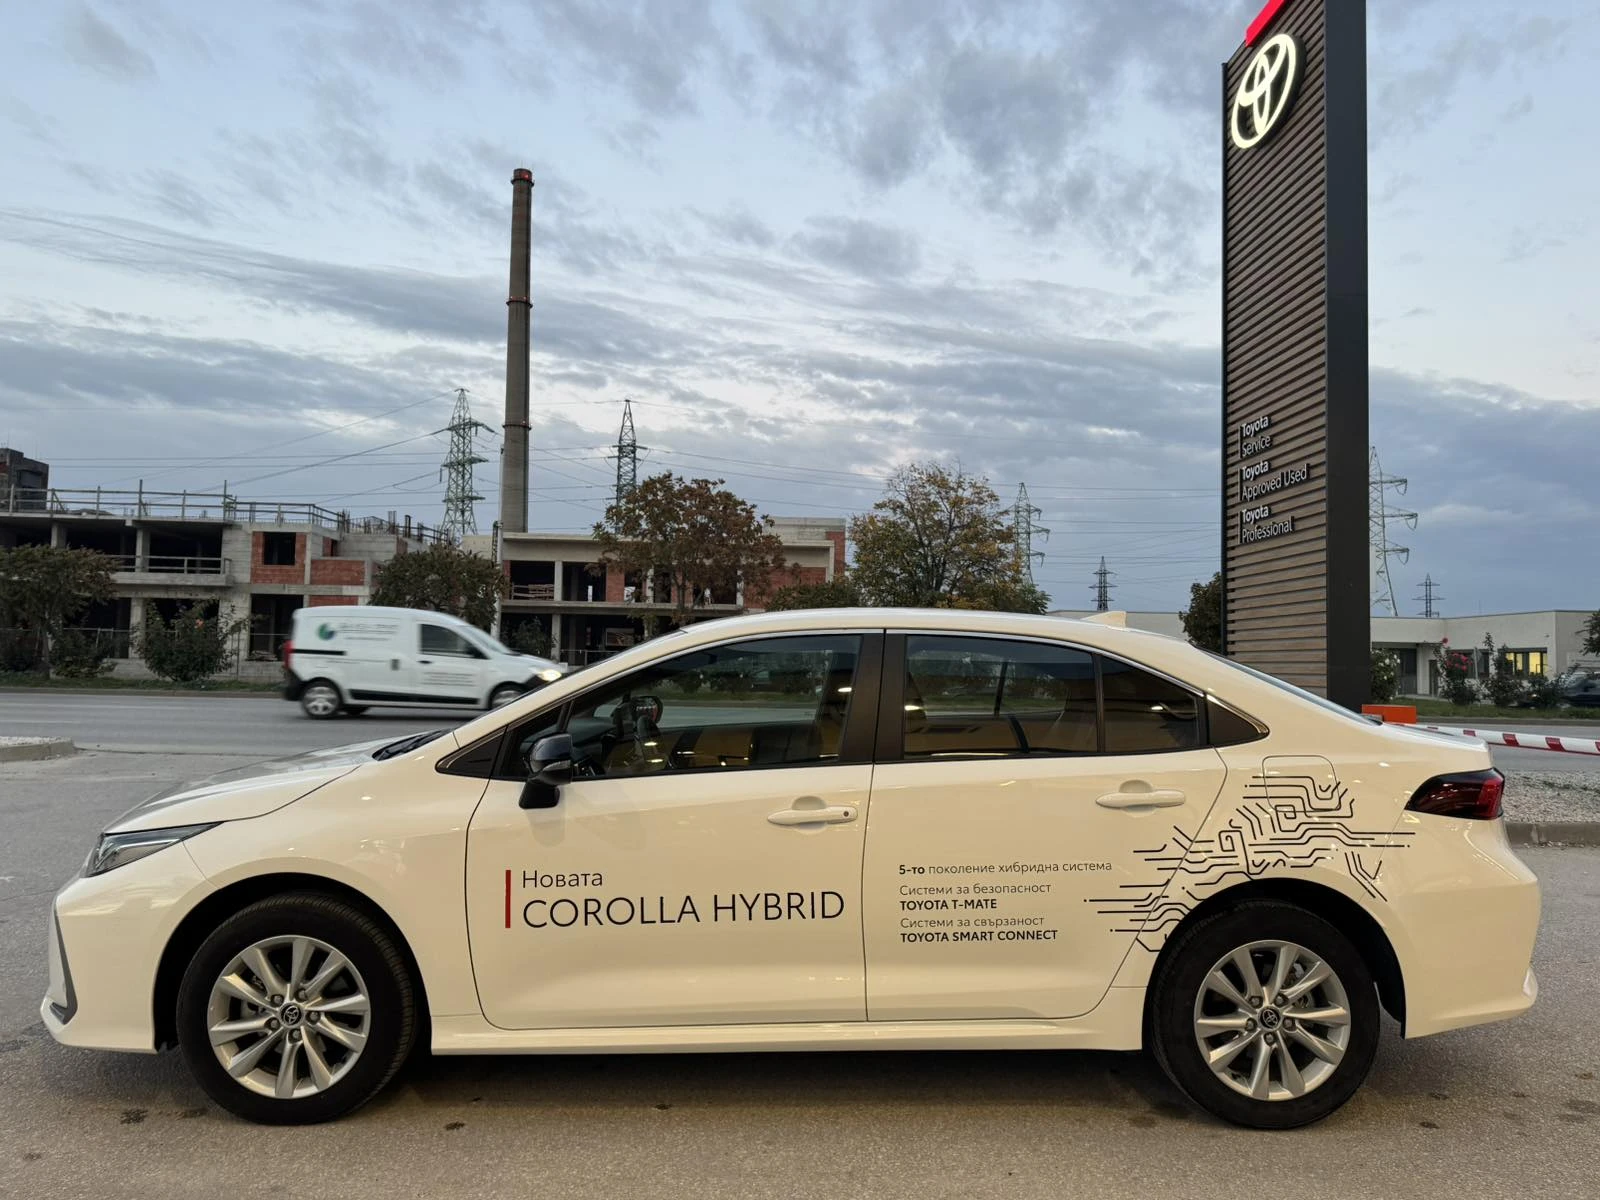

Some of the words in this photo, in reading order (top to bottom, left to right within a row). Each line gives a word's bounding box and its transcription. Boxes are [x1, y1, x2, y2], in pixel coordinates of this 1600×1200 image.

[1242, 416, 1269, 437] Toyota
[1242, 435, 1270, 457] Service
[1242, 461, 1269, 481] Toyota
[1242, 473, 1282, 501] Approved
[1283, 463, 1307, 486] Used
[1242, 506, 1269, 525] Toyota
[1242, 516, 1293, 543] Professional
[899, 864, 925, 875] 5-то
[928, 864, 995, 874] поколение
[998, 862, 1059, 874] хибридна
[1062, 861, 1112, 872] система
[522, 870, 603, 888] Новата
[899, 885, 953, 896] Системи
[955, 884, 970, 895] за
[973, 883, 1051, 895] безопасност
[523, 895, 701, 928] COROLLA
[713, 891, 845, 922] HYBRID
[900, 900, 949, 911] TOYOTA
[951, 899, 998, 910] T-MATE
[900, 918, 953, 929] Системи
[956, 917, 971, 928] за
[973, 916, 1044, 929] свързаност
[901, 932, 950, 943] TOYOTA
[952, 931, 995, 942] SMART
[997, 930, 1058, 941] CONNECT
